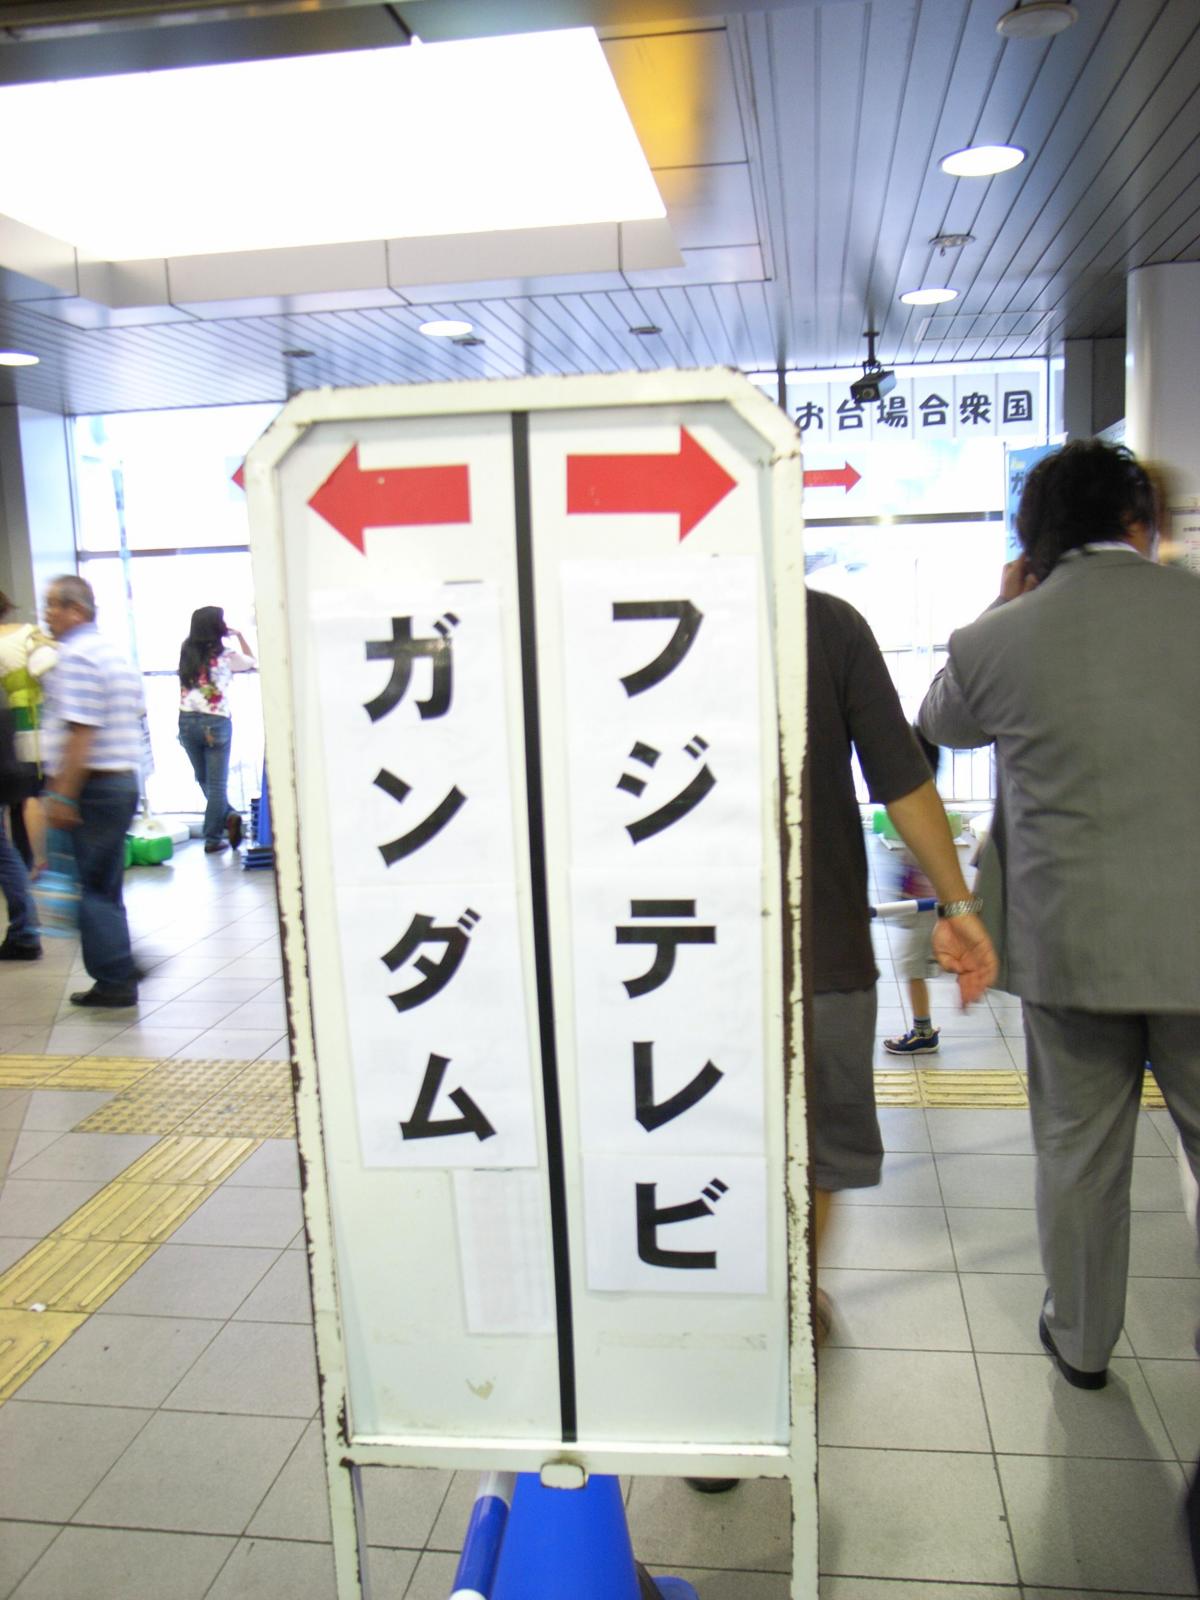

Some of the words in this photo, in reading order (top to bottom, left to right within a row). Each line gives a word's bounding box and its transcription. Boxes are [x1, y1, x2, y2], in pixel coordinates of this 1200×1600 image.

[796, 389, 1033, 431] お台場合衆国
[363, 612, 496, 1142] ガンダム
[612, 600, 729, 1269] フジテレビ
